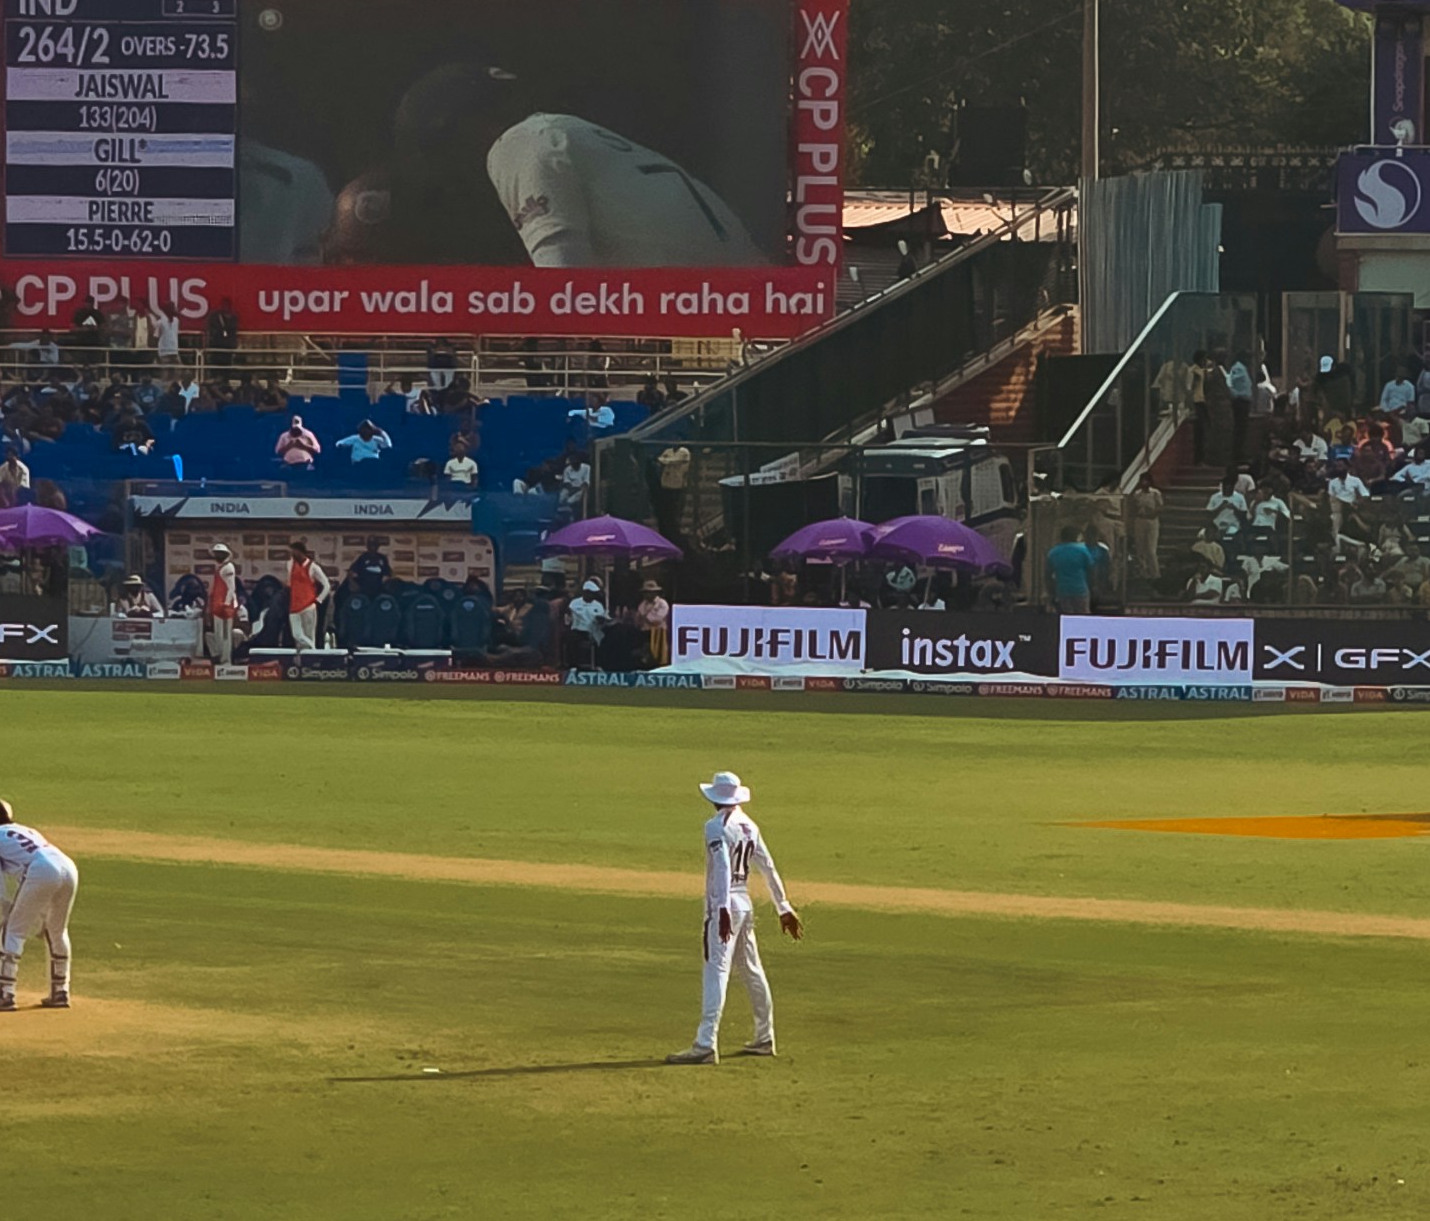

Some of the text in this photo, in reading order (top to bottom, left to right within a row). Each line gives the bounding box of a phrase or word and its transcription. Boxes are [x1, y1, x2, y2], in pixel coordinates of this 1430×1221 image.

[18, 26, 110, 65] 264/2
[121, 36, 176, 55] OVERS
[75, 74, 169, 99] JAISWAL
[79, 105, 157, 132] 133(204)
[796, 67, 839, 265] CP PLUS
[95, 170, 140, 195] 6(20)
[88, 201, 155, 222] PIERRE
[67, 228, 171, 252] 15.5-0-62-0
[16, 275, 77, 317] CP
[259, 282, 825, 319] upar wala sab dekh raha hai
[211, 502, 250, 514] INDIA
[354, 504, 394, 516] INDIA
[677, 626, 860, 659] FUJIFILM
[1065, 638, 1249, 671] FUJIFILM
[1263, 646, 1305, 670] X
[11, 664, 73, 678] ASTRAL
[81, 664, 143, 678] ASTRAL
[184, 667, 211, 677] VIDA
[252, 668, 278, 678] VIDA
[301, 667, 348, 680] Simpolo
[371, 668, 418, 681] Simpolo
[566, 671, 628, 686] ASTRAL
[634, 674, 697, 688] ASTRAL
[740, 678, 766, 687] VIDA
[809, 680, 835, 689] VIDA
[1116, 686, 1179, 700] ASTRAL
[1187, 686, 1249, 700] ASTRAL
[1289, 690, 1316, 700] VIDA
[1357, 691, 1384, 700] VIDA
